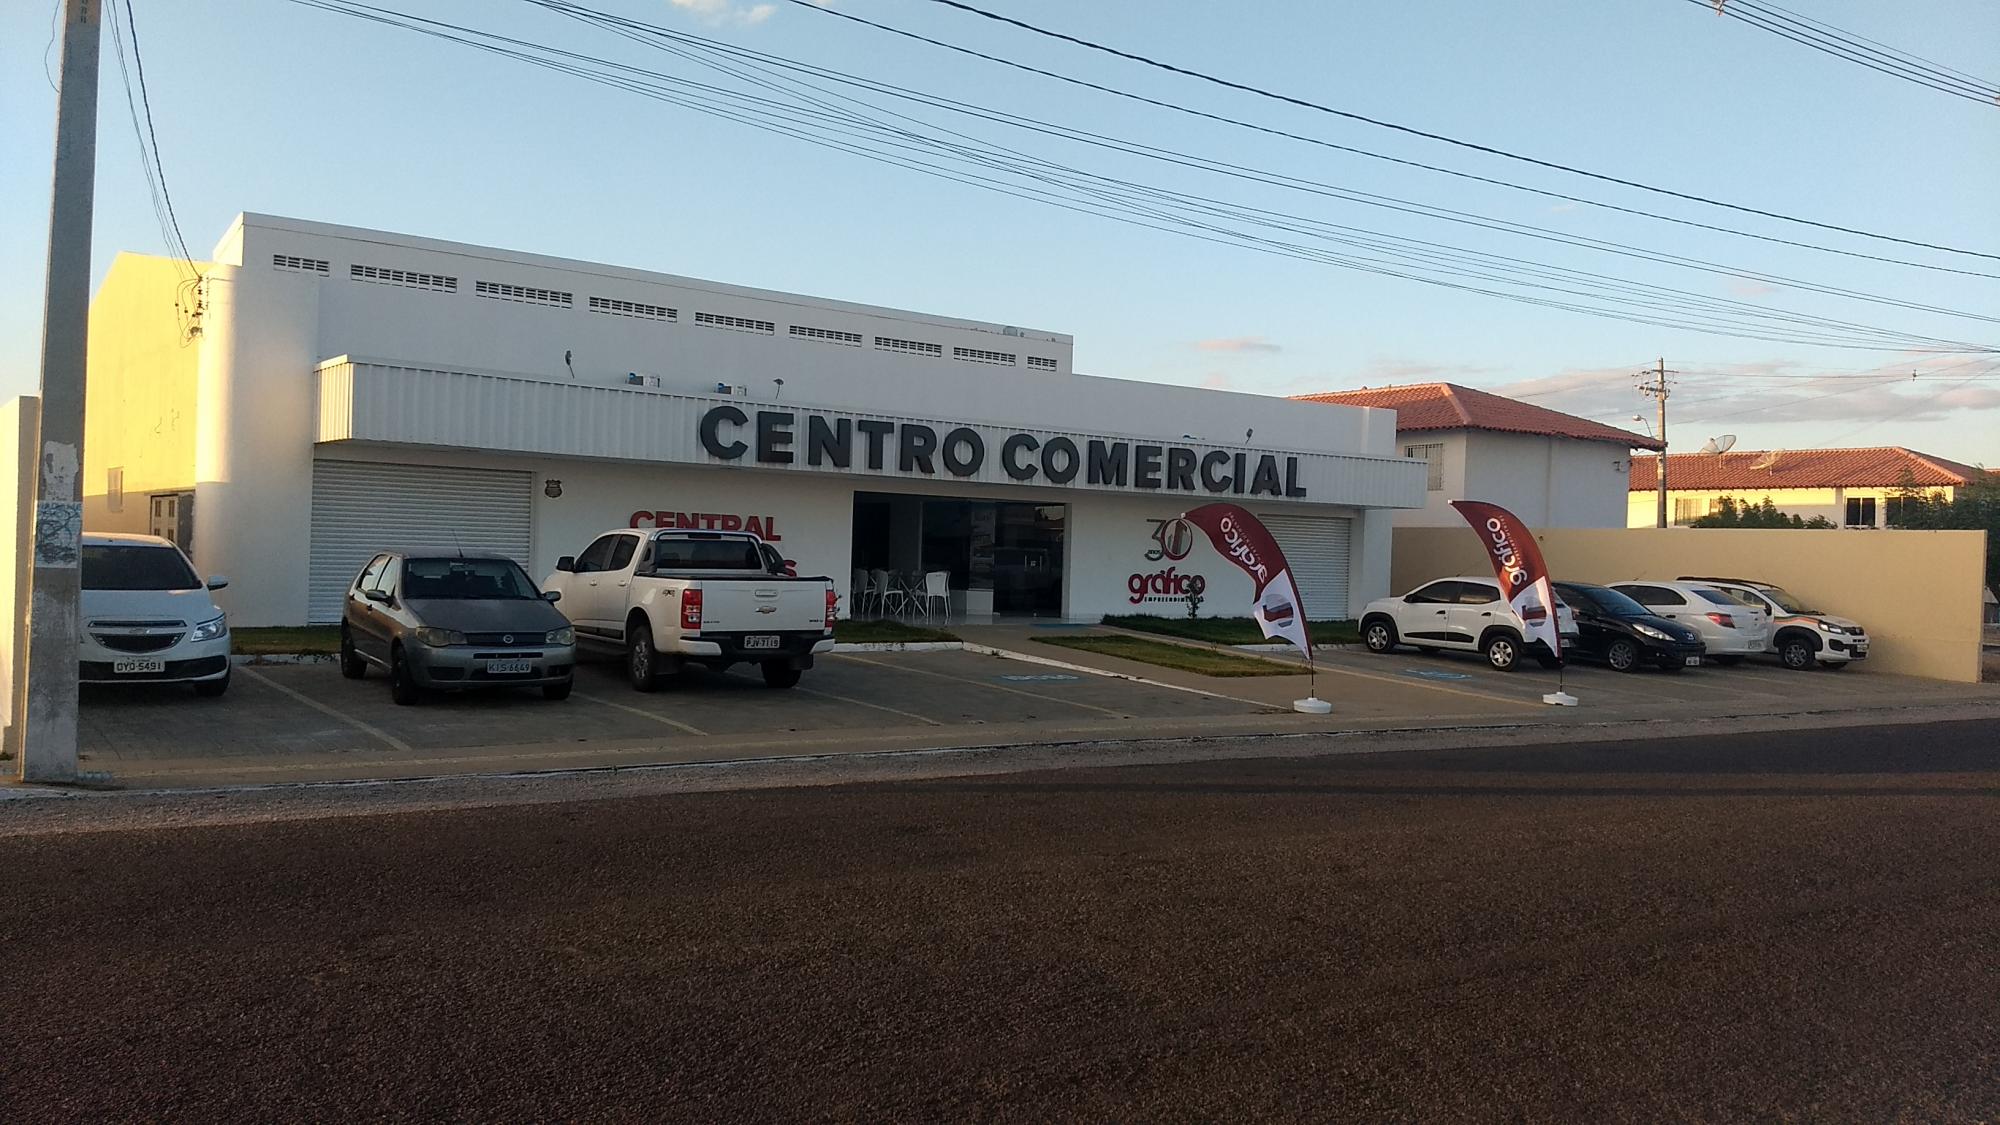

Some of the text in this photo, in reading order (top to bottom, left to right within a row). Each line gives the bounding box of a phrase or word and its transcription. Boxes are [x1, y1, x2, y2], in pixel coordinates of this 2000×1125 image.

[700, 405, 1307, 497] CENTRO COMERCIAL
[629, 510, 782, 541] CENTRAL
